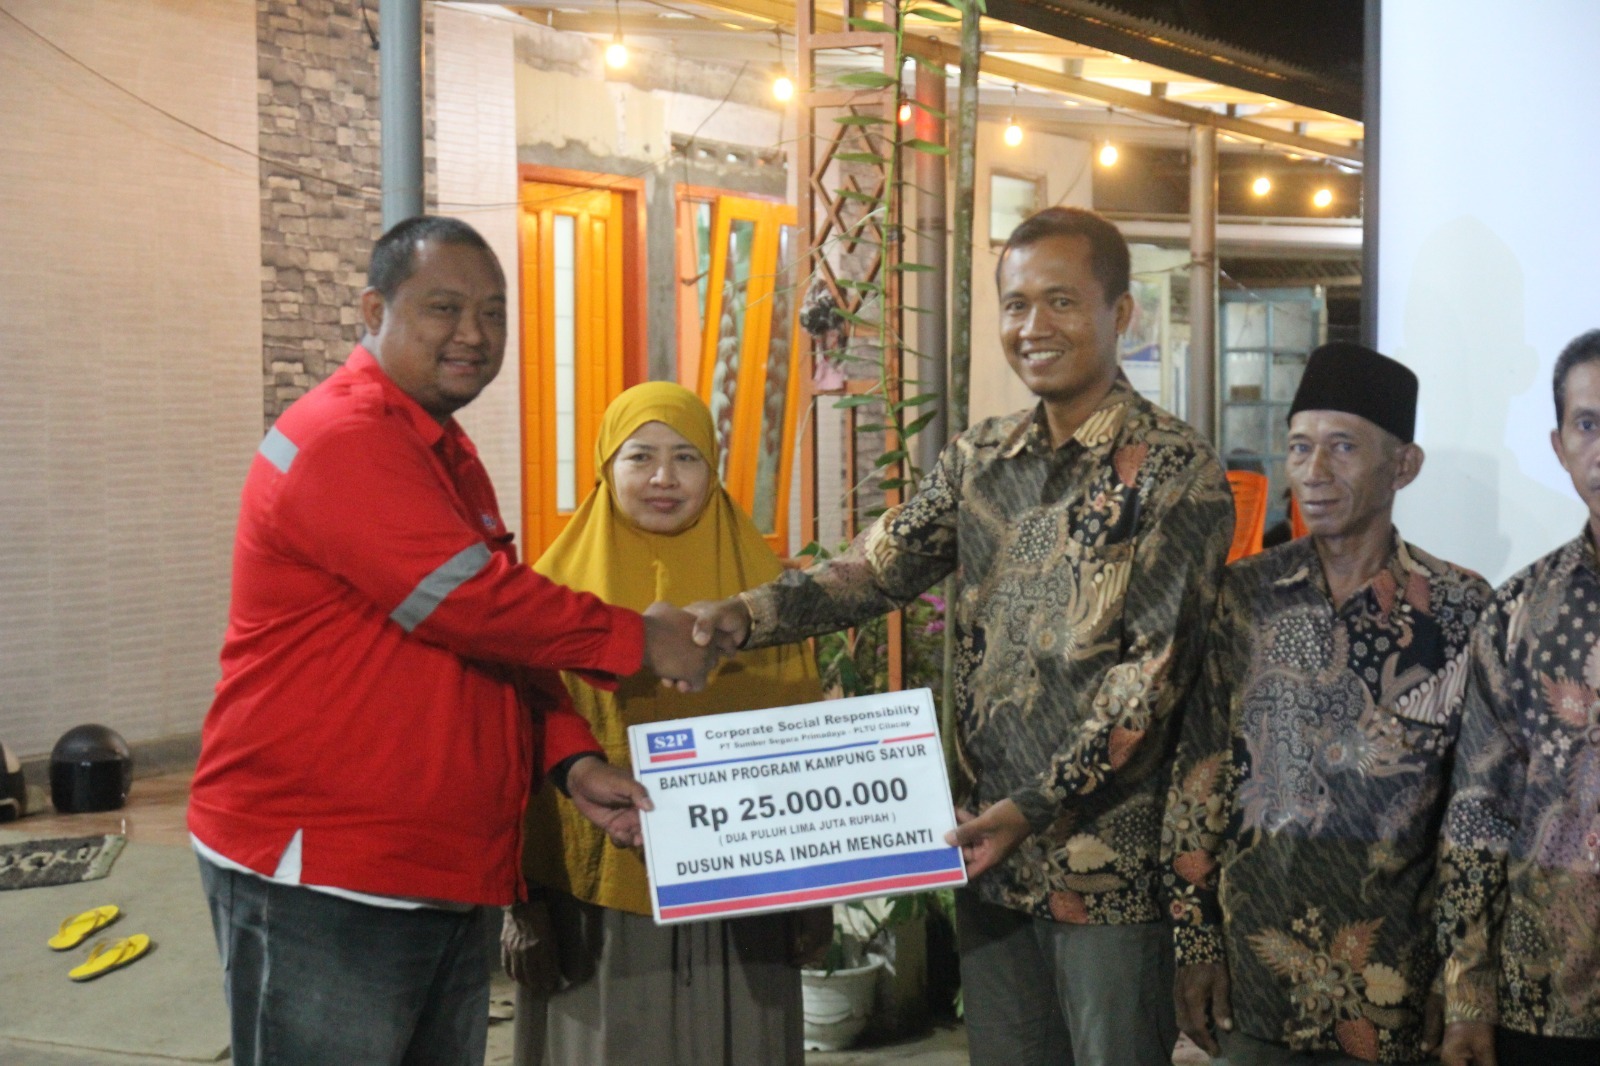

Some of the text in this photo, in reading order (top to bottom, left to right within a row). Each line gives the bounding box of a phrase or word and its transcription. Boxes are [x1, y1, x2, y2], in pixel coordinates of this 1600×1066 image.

[653, 732, 689, 749] S2P
[705, 705, 921, 740] Corporate Social Responsibility
[660, 744, 927, 790] BANTUAN PROGRAM KAMPUNG SAYUR
[688, 777, 908, 832] Rp 25.000.000
[726, 832, 748, 844] DUA
[751, 826, 787, 840] PULUH
[790, 822, 816, 835] LIMA
[820, 818, 846, 831] JUTA
[849, 812, 890, 826] RUPIAH
[677, 828, 934, 876] DUSUN NUSA INDAH MENGANTI
